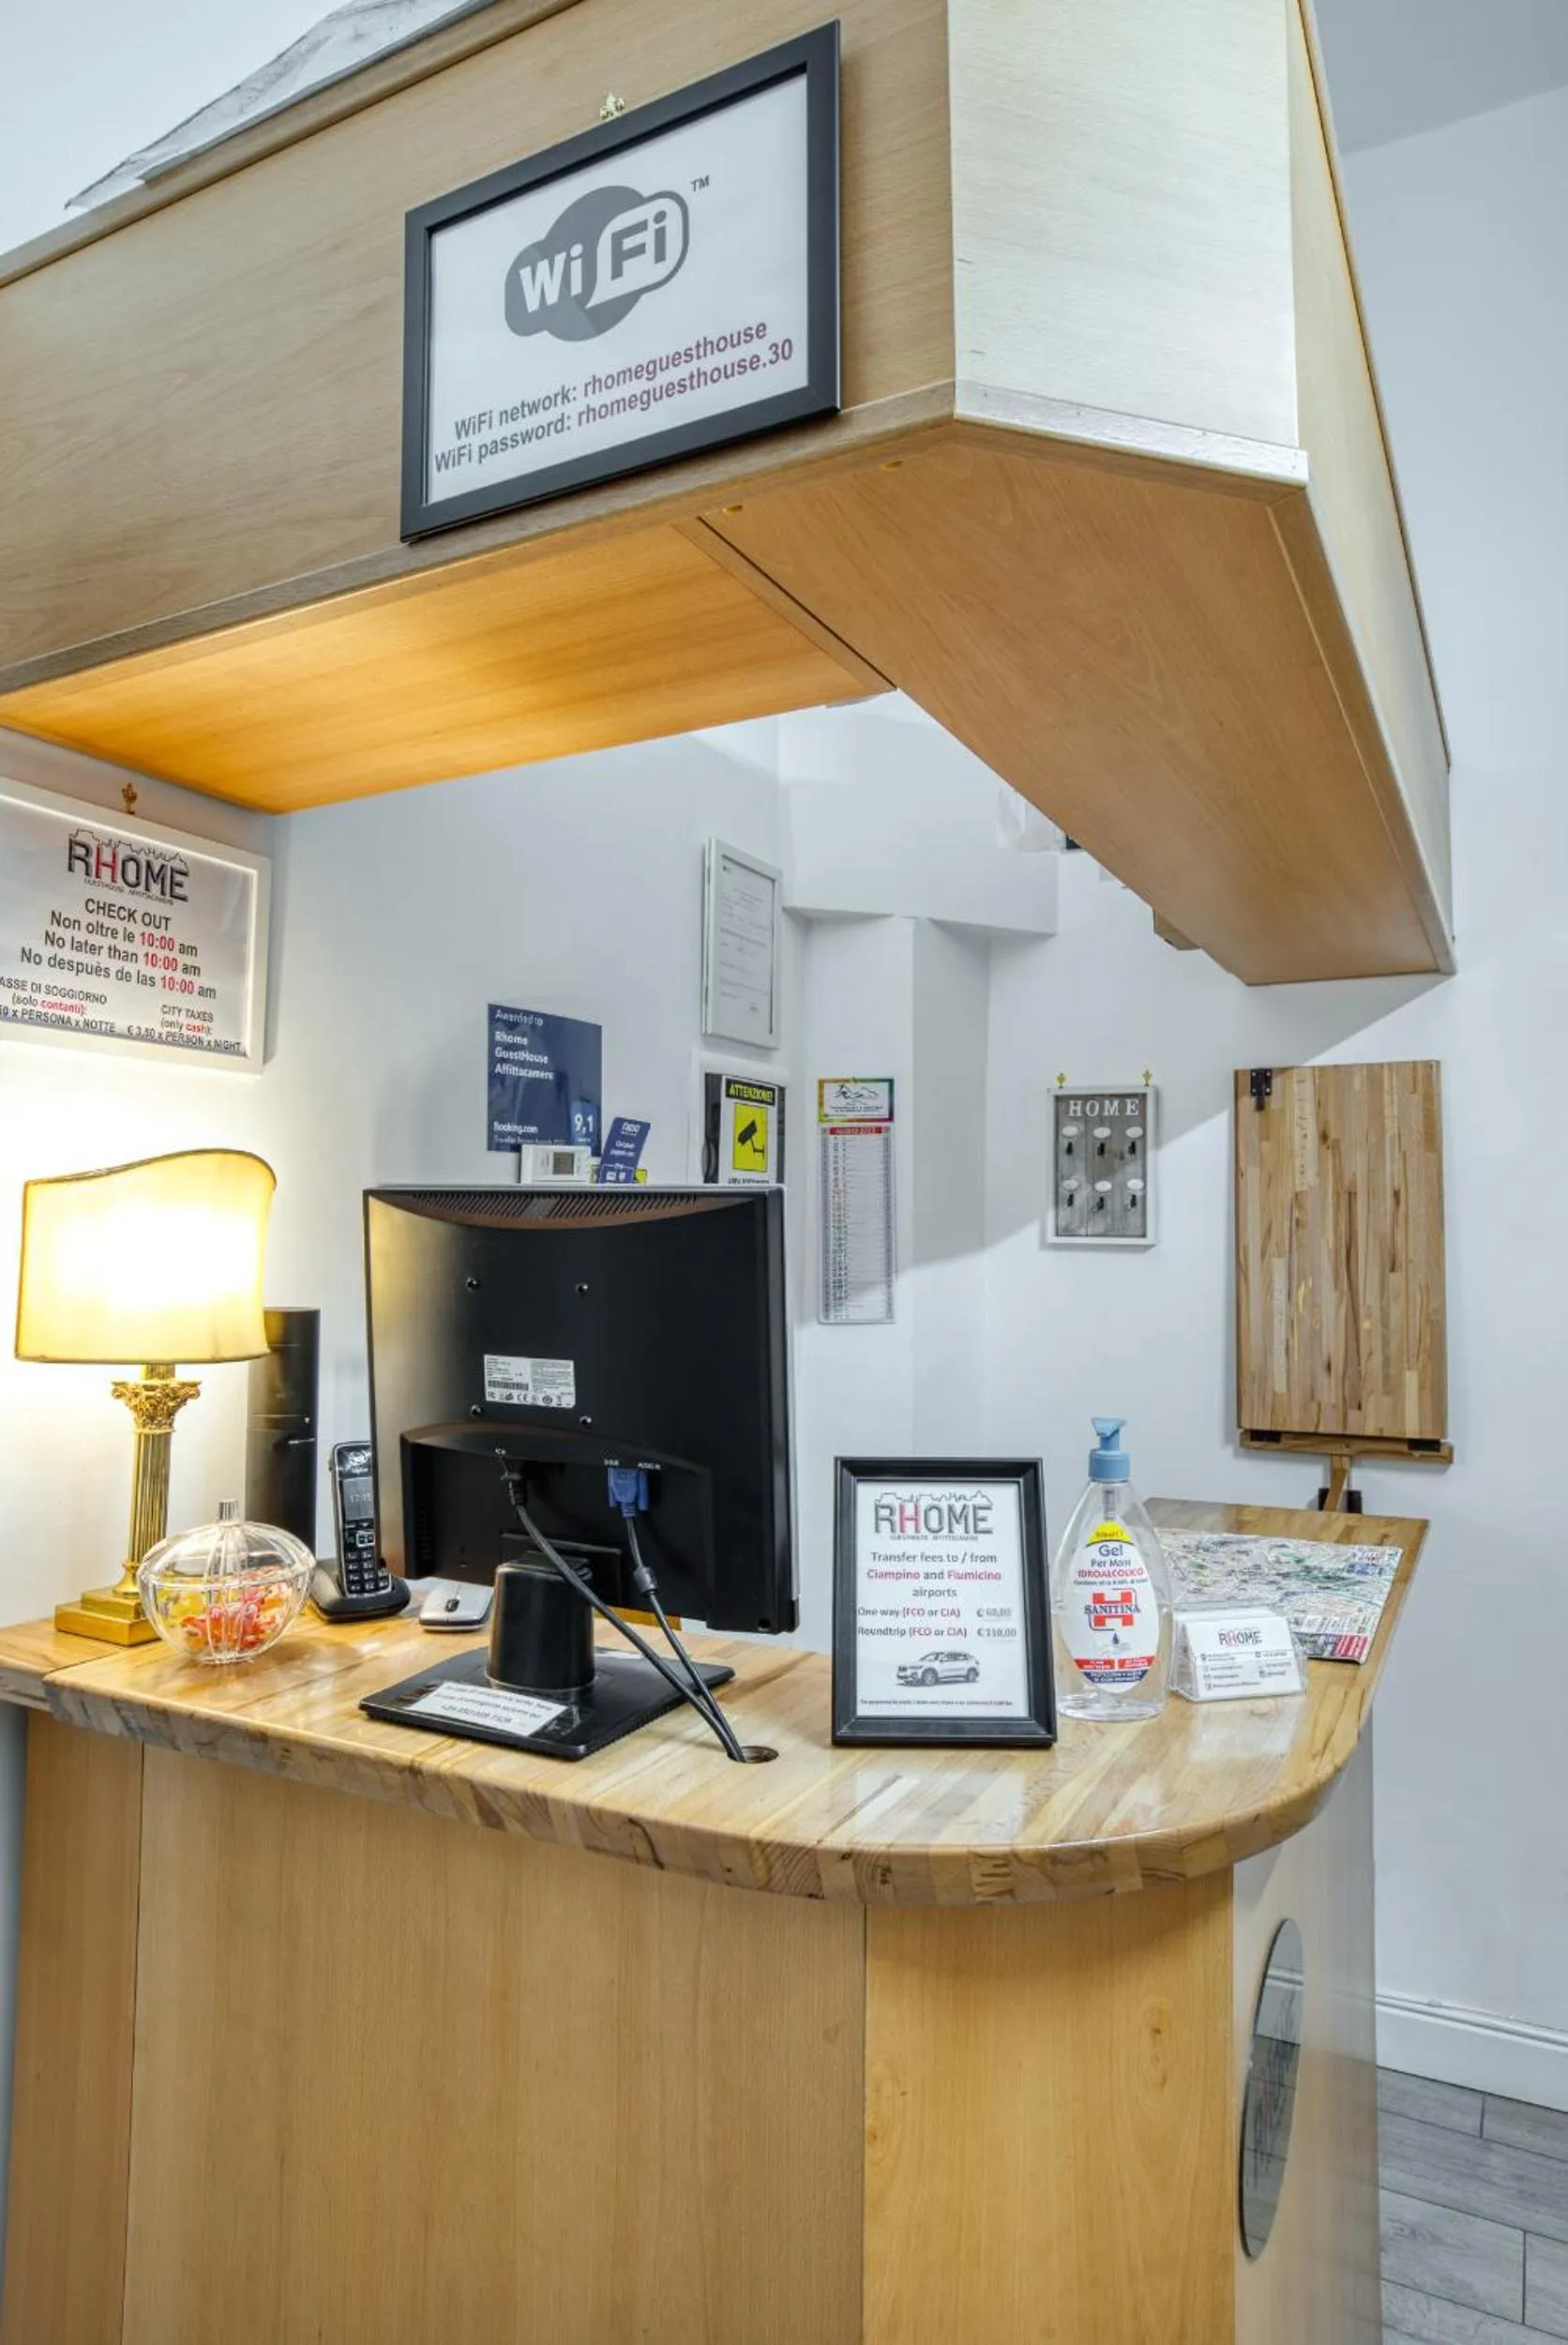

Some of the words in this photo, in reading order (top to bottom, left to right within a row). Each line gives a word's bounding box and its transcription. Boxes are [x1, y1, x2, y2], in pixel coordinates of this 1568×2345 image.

[455, 409, 493, 440] WiFi
[499, 385, 577, 428] network:
[583, 322, 767, 398] rhomeguesthouse
[435, 444, 472, 473] WiFi
[478, 416, 571, 465] password:
[578, 338, 793, 426] rhomeguesthouse.30
[68, 838, 188, 902] RHOME
[85, 898, 137, 924] CHECK
[142, 912, 172, 931] OUT
[51, 910, 81, 931] Non
[85, 920, 118, 939] oltre
[122, 927, 135, 944] le
[139, 931, 174, 951] 10:00
[178, 943, 198, 957] am
[44, 930, 65, 949] No
[70, 937, 103, 957] later
[107, 946, 139, 963] than
[143, 952, 178, 972] 10:00
[181, 962, 201, 976] am
[20, 946, 42, 965] No
[115, 967, 132, 982] de
[137, 970, 156, 987] las
[160, 975, 195, 994] 10:00
[198, 985, 217, 999] am
[30, 982, 41, 993] DI
[44, 984, 107, 1005] SOGGIORNO
[22, 1008, 72, 1026] PERSONA
[83, 1019, 115, 1033] NOTTE
[160, 1005, 182, 1018] CITY
[185, 1008, 214, 1022] TAXES
[495, 1009, 534, 1025] Awarded
[535, 1016, 543, 1026] to
[165, 1032, 204, 1047] PERSON
[1068, 1098, 1139, 1117] HOME
[493, 1121, 539, 1135] Booking.com
[874, 1502, 994, 1535] RHOME
[870, 1552, 917, 1564] Transfer
[920, 1552, 943, 1564] fees
[946, 1553, 958, 1564] to
[970, 1552, 997, 1564] from
[1098, 1544, 1123, 1557] Gel
[1091, 1558, 1107, 1567] Per
[1109, 1558, 1131, 1567] Mani
[867, 1569, 921, 1581] Ciampino
[923, 1570, 945, 1581] and
[947, 1570, 1002, 1581] Fiumicino
[912, 1587, 957, 1598] airports
[857, 1608, 878, 1617] One
[880, 1609, 900, 1618] way
[902, 1607, 926, 1618] (FCO
[927, 1609, 938, 1617] or
[941, 1608, 961, 1618] CIA)
[1084, 1605, 1141, 1614] SANITINA
[857, 1626, 906, 1639] Roundtrip
[909, 1626, 932, 1638] (FCO
[934, 1627, 944, 1637] or
[946, 1626, 968, 1638] CIA)
[1218, 1630, 1263, 1645] RHOME
